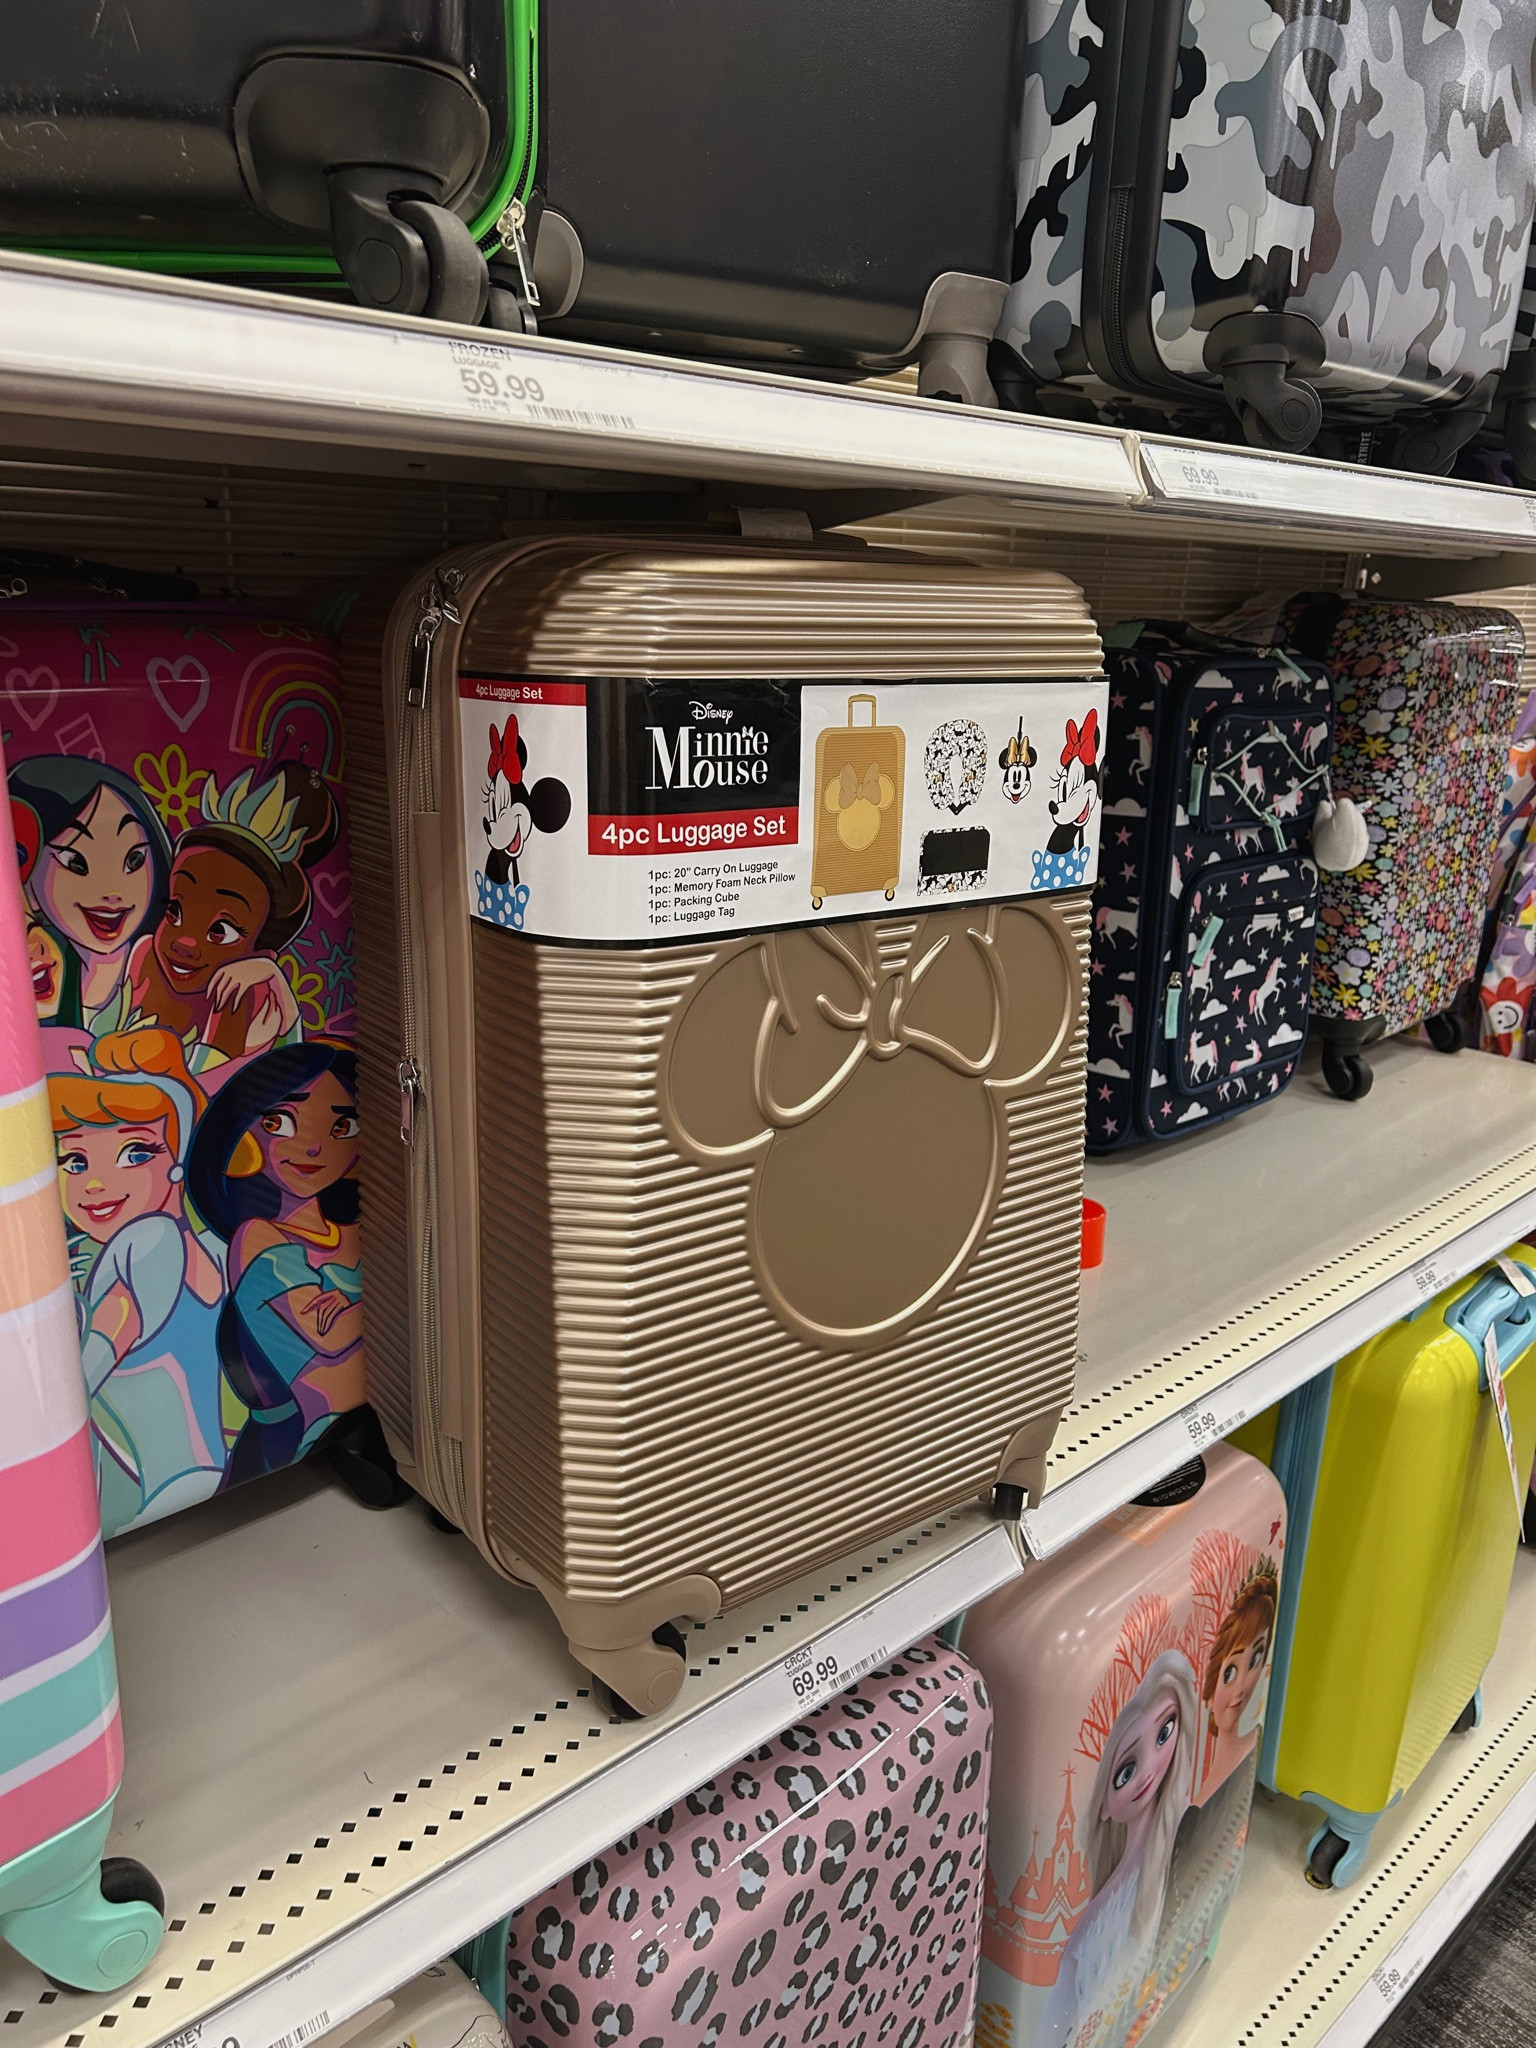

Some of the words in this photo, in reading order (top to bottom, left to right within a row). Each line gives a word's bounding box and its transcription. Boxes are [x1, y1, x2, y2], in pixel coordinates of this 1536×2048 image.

[448, 341, 512, 362] FROZEN
[452, 356, 501, 370] LUGGAGE
[460, 368, 545, 402] 59.99
[1357, 431, 1371, 464] RTNITE
[1182, 466, 1219, 486] 69.99
[475, 683, 489, 698] 4pc
[489, 684, 520, 701] Luggage
[522, 686, 544, 700] Set
[601, 822, 650, 850] 4pc
[657, 821, 747, 847] Luggage
[753, 815, 786, 837] Set
[648, 870, 671, 882] 1pc:
[693, 866, 720, 877] Carry
[723, 864, 737, 873] On
[739, 861, 779, 873] Luggage
[648, 885, 671, 896] 1pc:
[674, 881, 713, 893] Memory
[716, 878, 741, 889] Foam
[743, 875, 767, 886] Neck
[769, 872, 796, 883] Pillow
[648, 899, 671, 911] 1pc:
[674, 895, 712, 907] Packing
[715, 892, 740, 903] Cube
[648, 914, 671, 925] 1pc:
[674, 909, 716, 922] Luggage
[718, 906, 735, 918] Tag
[1187, 1412, 1216, 1439] 59.99
[784, 1646, 813, 1670] CRCKT
[792, 1656, 838, 1697] 69.99
[1379, 1968, 1401, 1998] 59.99
